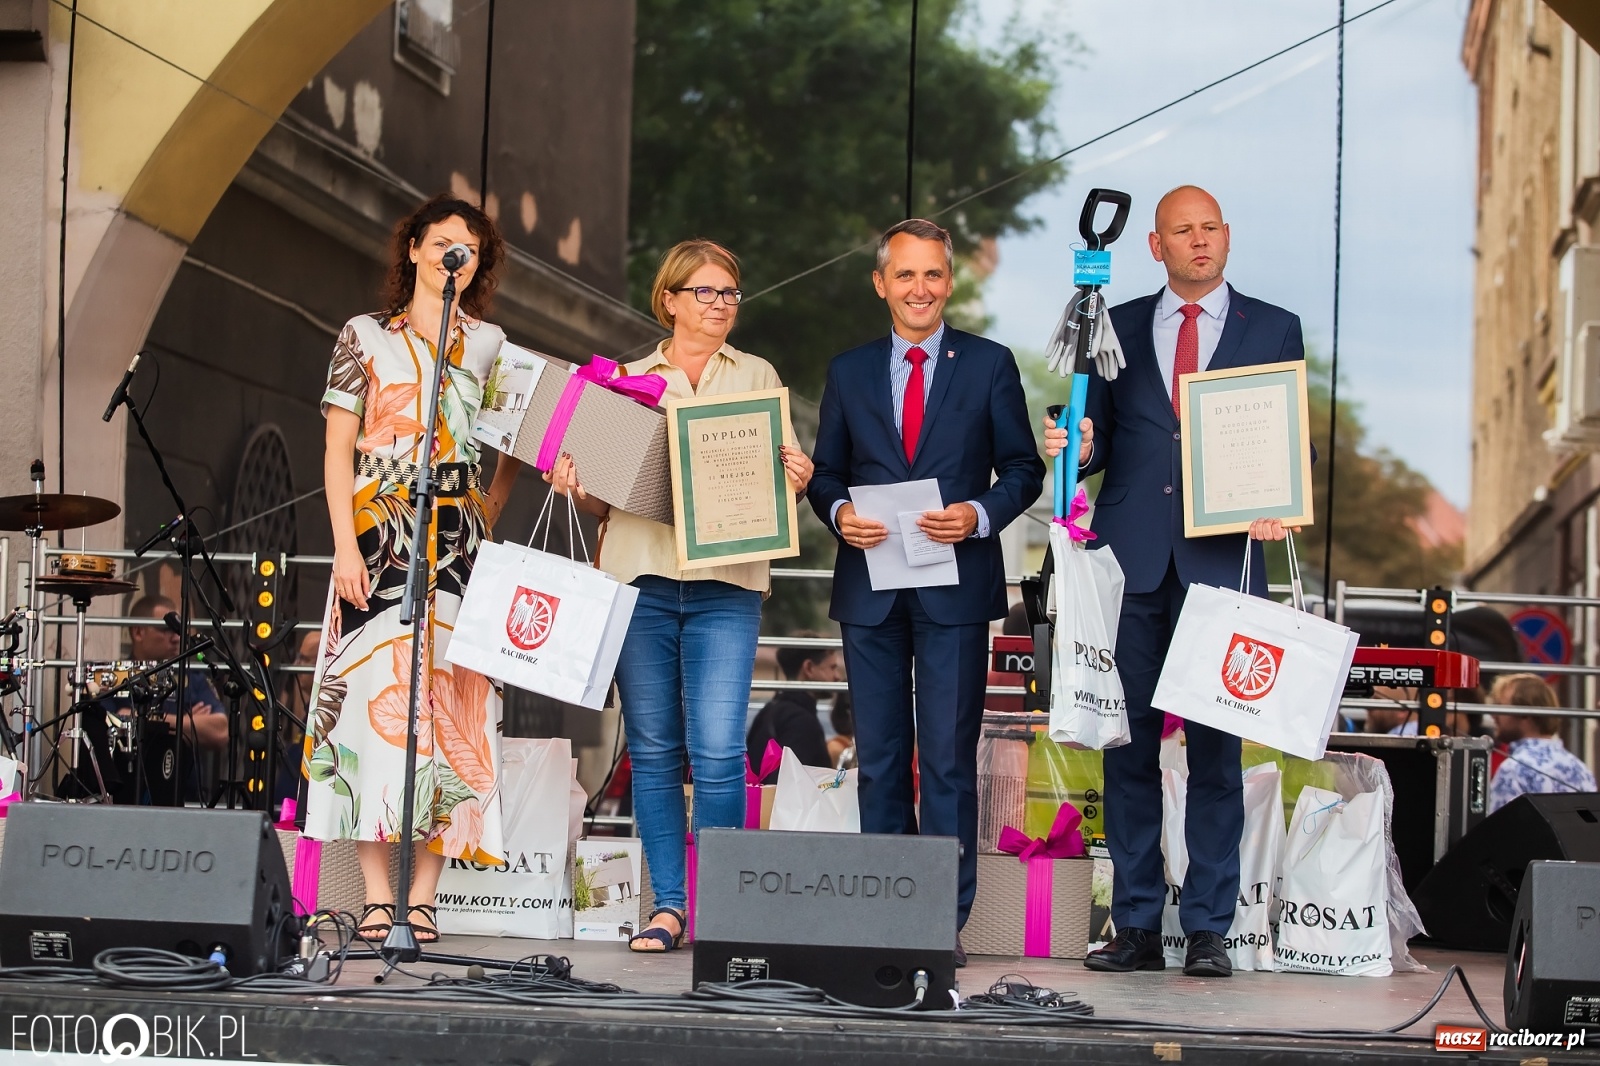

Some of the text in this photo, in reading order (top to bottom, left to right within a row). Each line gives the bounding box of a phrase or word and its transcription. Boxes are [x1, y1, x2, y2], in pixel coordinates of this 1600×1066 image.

[1215, 401, 1272, 415] DYPLOM
[702, 428, 757, 442] DYPLOM
[1231, 439, 1267, 447] MIEJSCA
[720, 471, 755, 479] MIEJSCA
[500, 647, 538, 665] RACIBÓRZ
[1216, 696, 1261, 716] RACIBÓRZ
[41, 844, 216, 873] POL-AUDIO
[738, 870, 917, 899] POL-AUDIO
